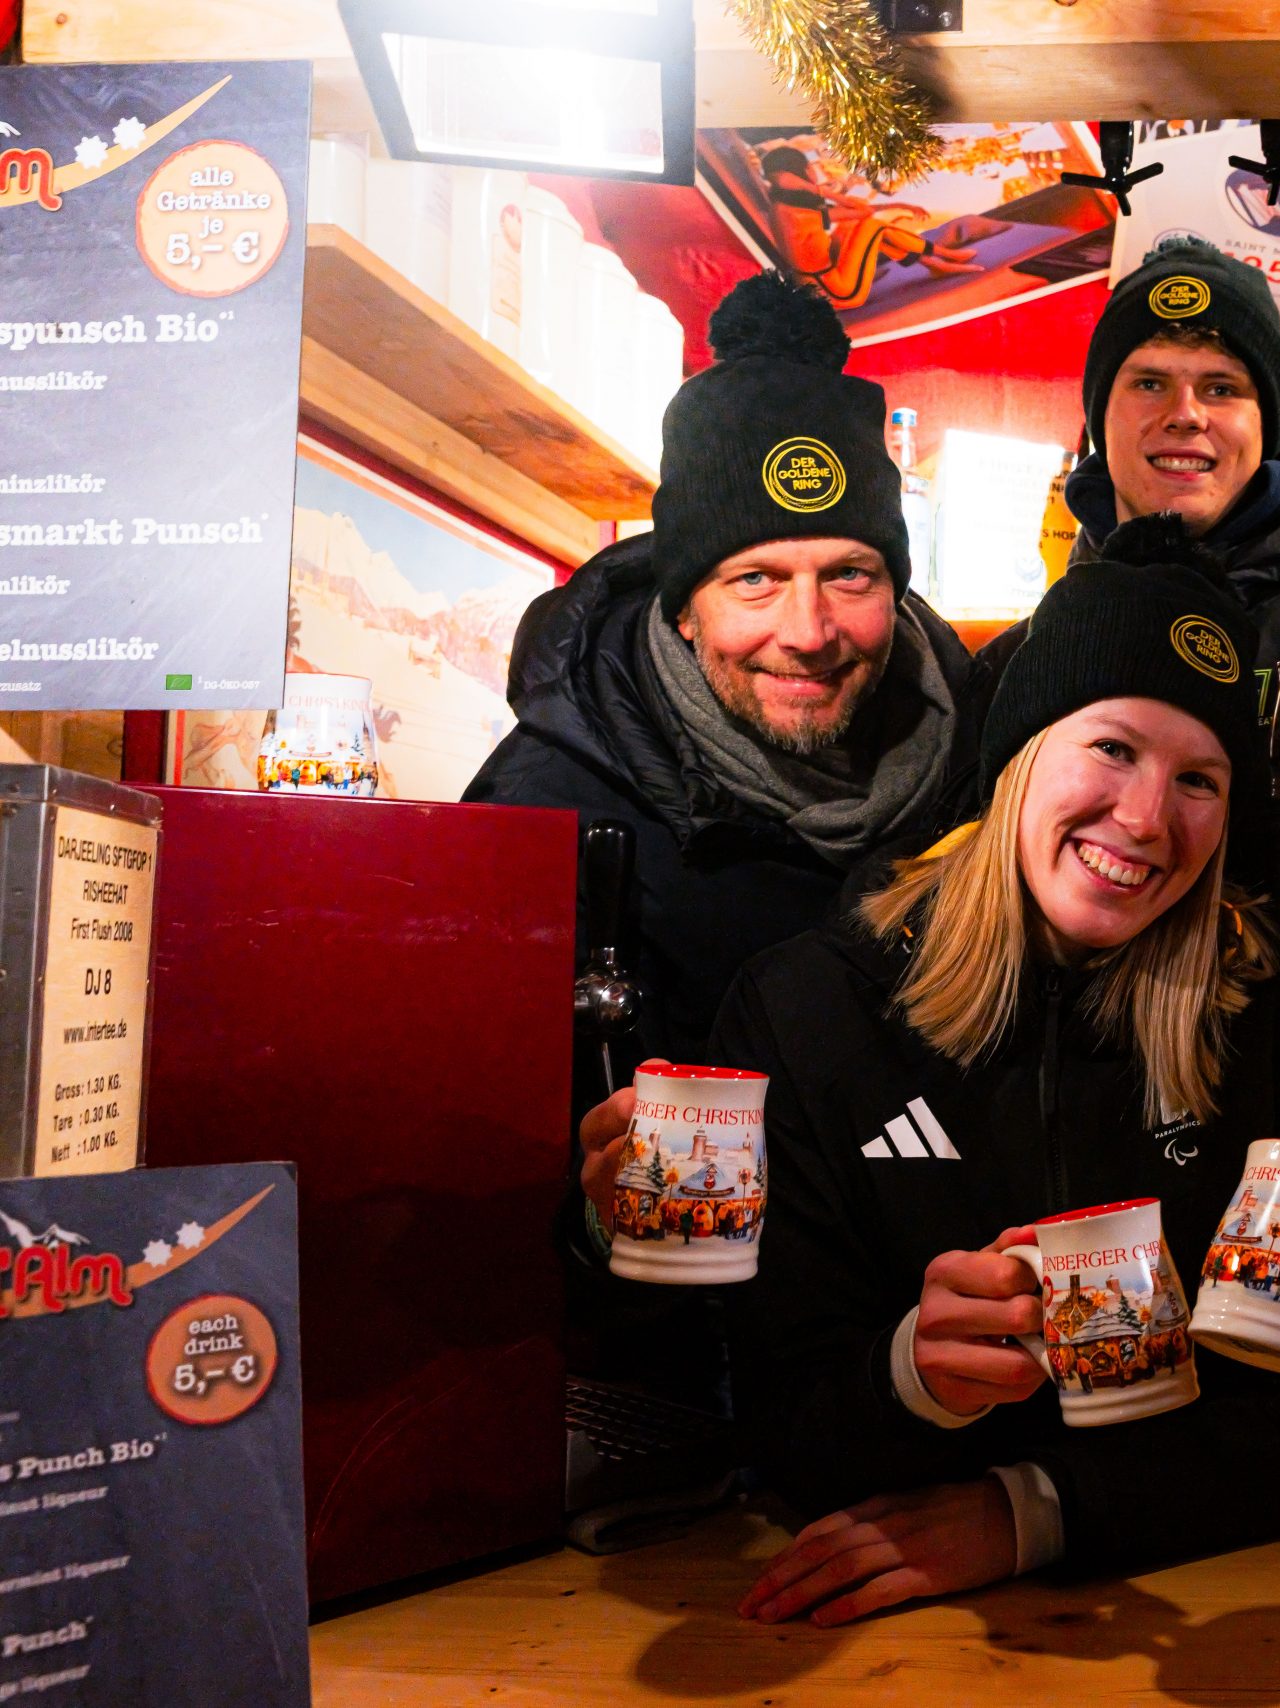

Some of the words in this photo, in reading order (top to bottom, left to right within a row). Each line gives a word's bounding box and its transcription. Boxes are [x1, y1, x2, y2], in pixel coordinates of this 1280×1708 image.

[190, 167, 234, 186] alle
[157, 191, 271, 211] Getränke
[199, 216, 223, 238] je
[231, 231, 260, 264] €
[1225, 239, 1266, 253] SAINT
[778, 467, 832, 479] GOLDENE
[791, 456, 816, 468] DER
[793, 479, 822, 491] RING
[1185, 632, 1230, 664] GOLDENE
[1200, 629, 1220, 648] DER
[1196, 644, 1221, 664] RING
[58, 836, 111, 866] DARJEELING
[112, 846, 146, 872] SFTGFOP
[83, 880, 128, 905] RISHEEHAT
[71, 918, 90, 939] First
[92, 920, 112, 941] Flush
[114, 921, 133, 942] 2008
[85, 968, 102, 995] DJ
[104, 969, 112, 994] 8
[64, 1018, 127, 1044] www.intertee.de
[87, 1077, 104, 1094] 1.30
[107, 1073, 122, 1090] KG.
[53, 1114, 73, 1132] Tare
[84, 1105, 104, 1124] 0.30
[105, 1102, 120, 1119] KG.
[1154, 1120, 1201, 1139] PARALYMPICS
[52, 1145, 71, 1162] Nett
[83, 1134, 100, 1152] 1.00
[104, 1130, 118, 1148] KG.
[188, 1314, 238, 1335] each
[184, 1333, 243, 1356] drink
[231, 1355, 255, 1383] €
[17, 1447, 105, 1479] Punch
